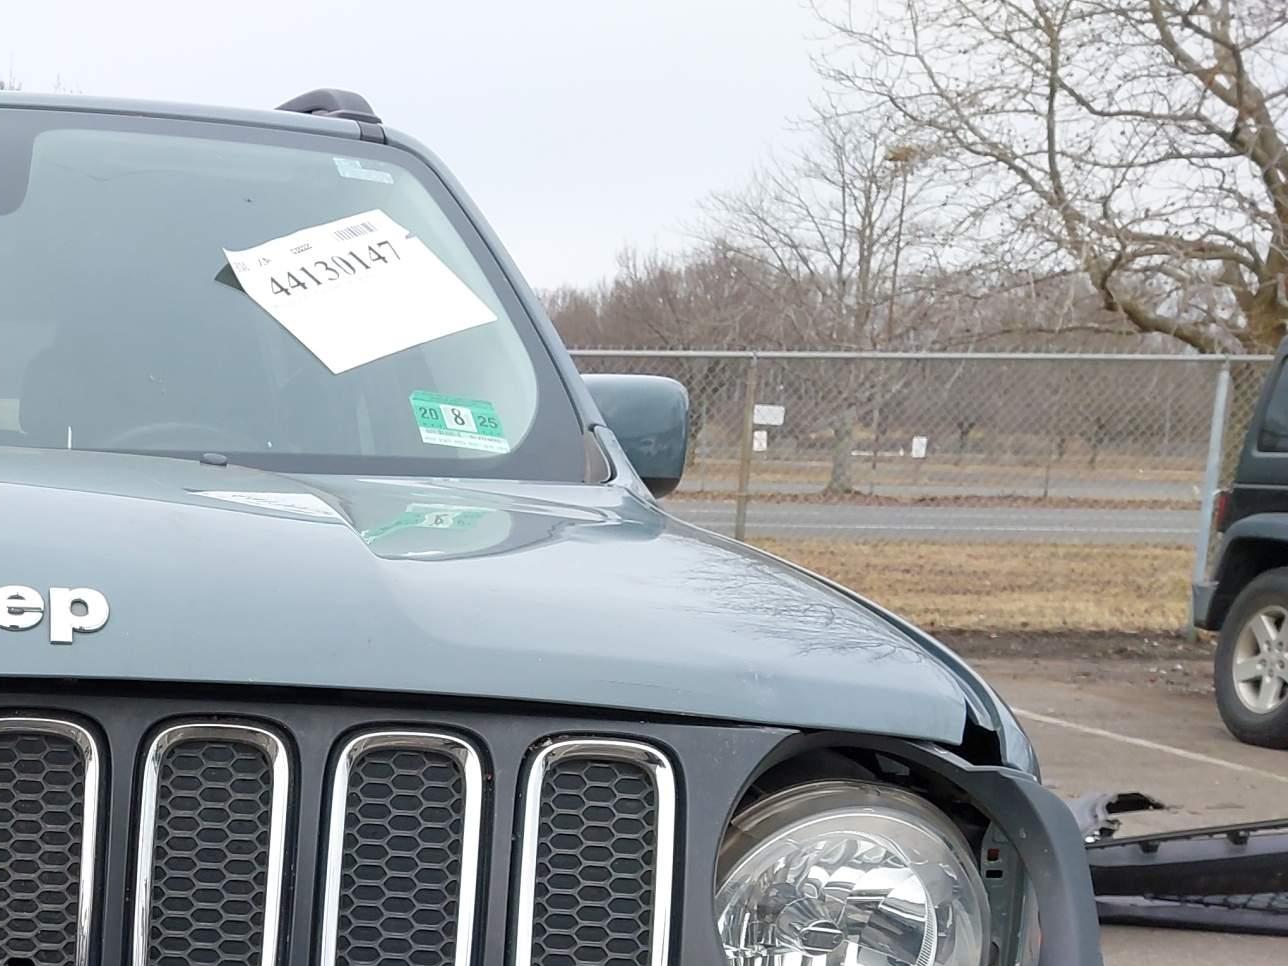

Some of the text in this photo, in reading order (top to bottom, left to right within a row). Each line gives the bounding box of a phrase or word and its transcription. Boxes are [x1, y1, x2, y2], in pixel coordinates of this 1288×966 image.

[270, 240, 400, 296] 44130147
[419, 407, 498, 429] 20 8 25
